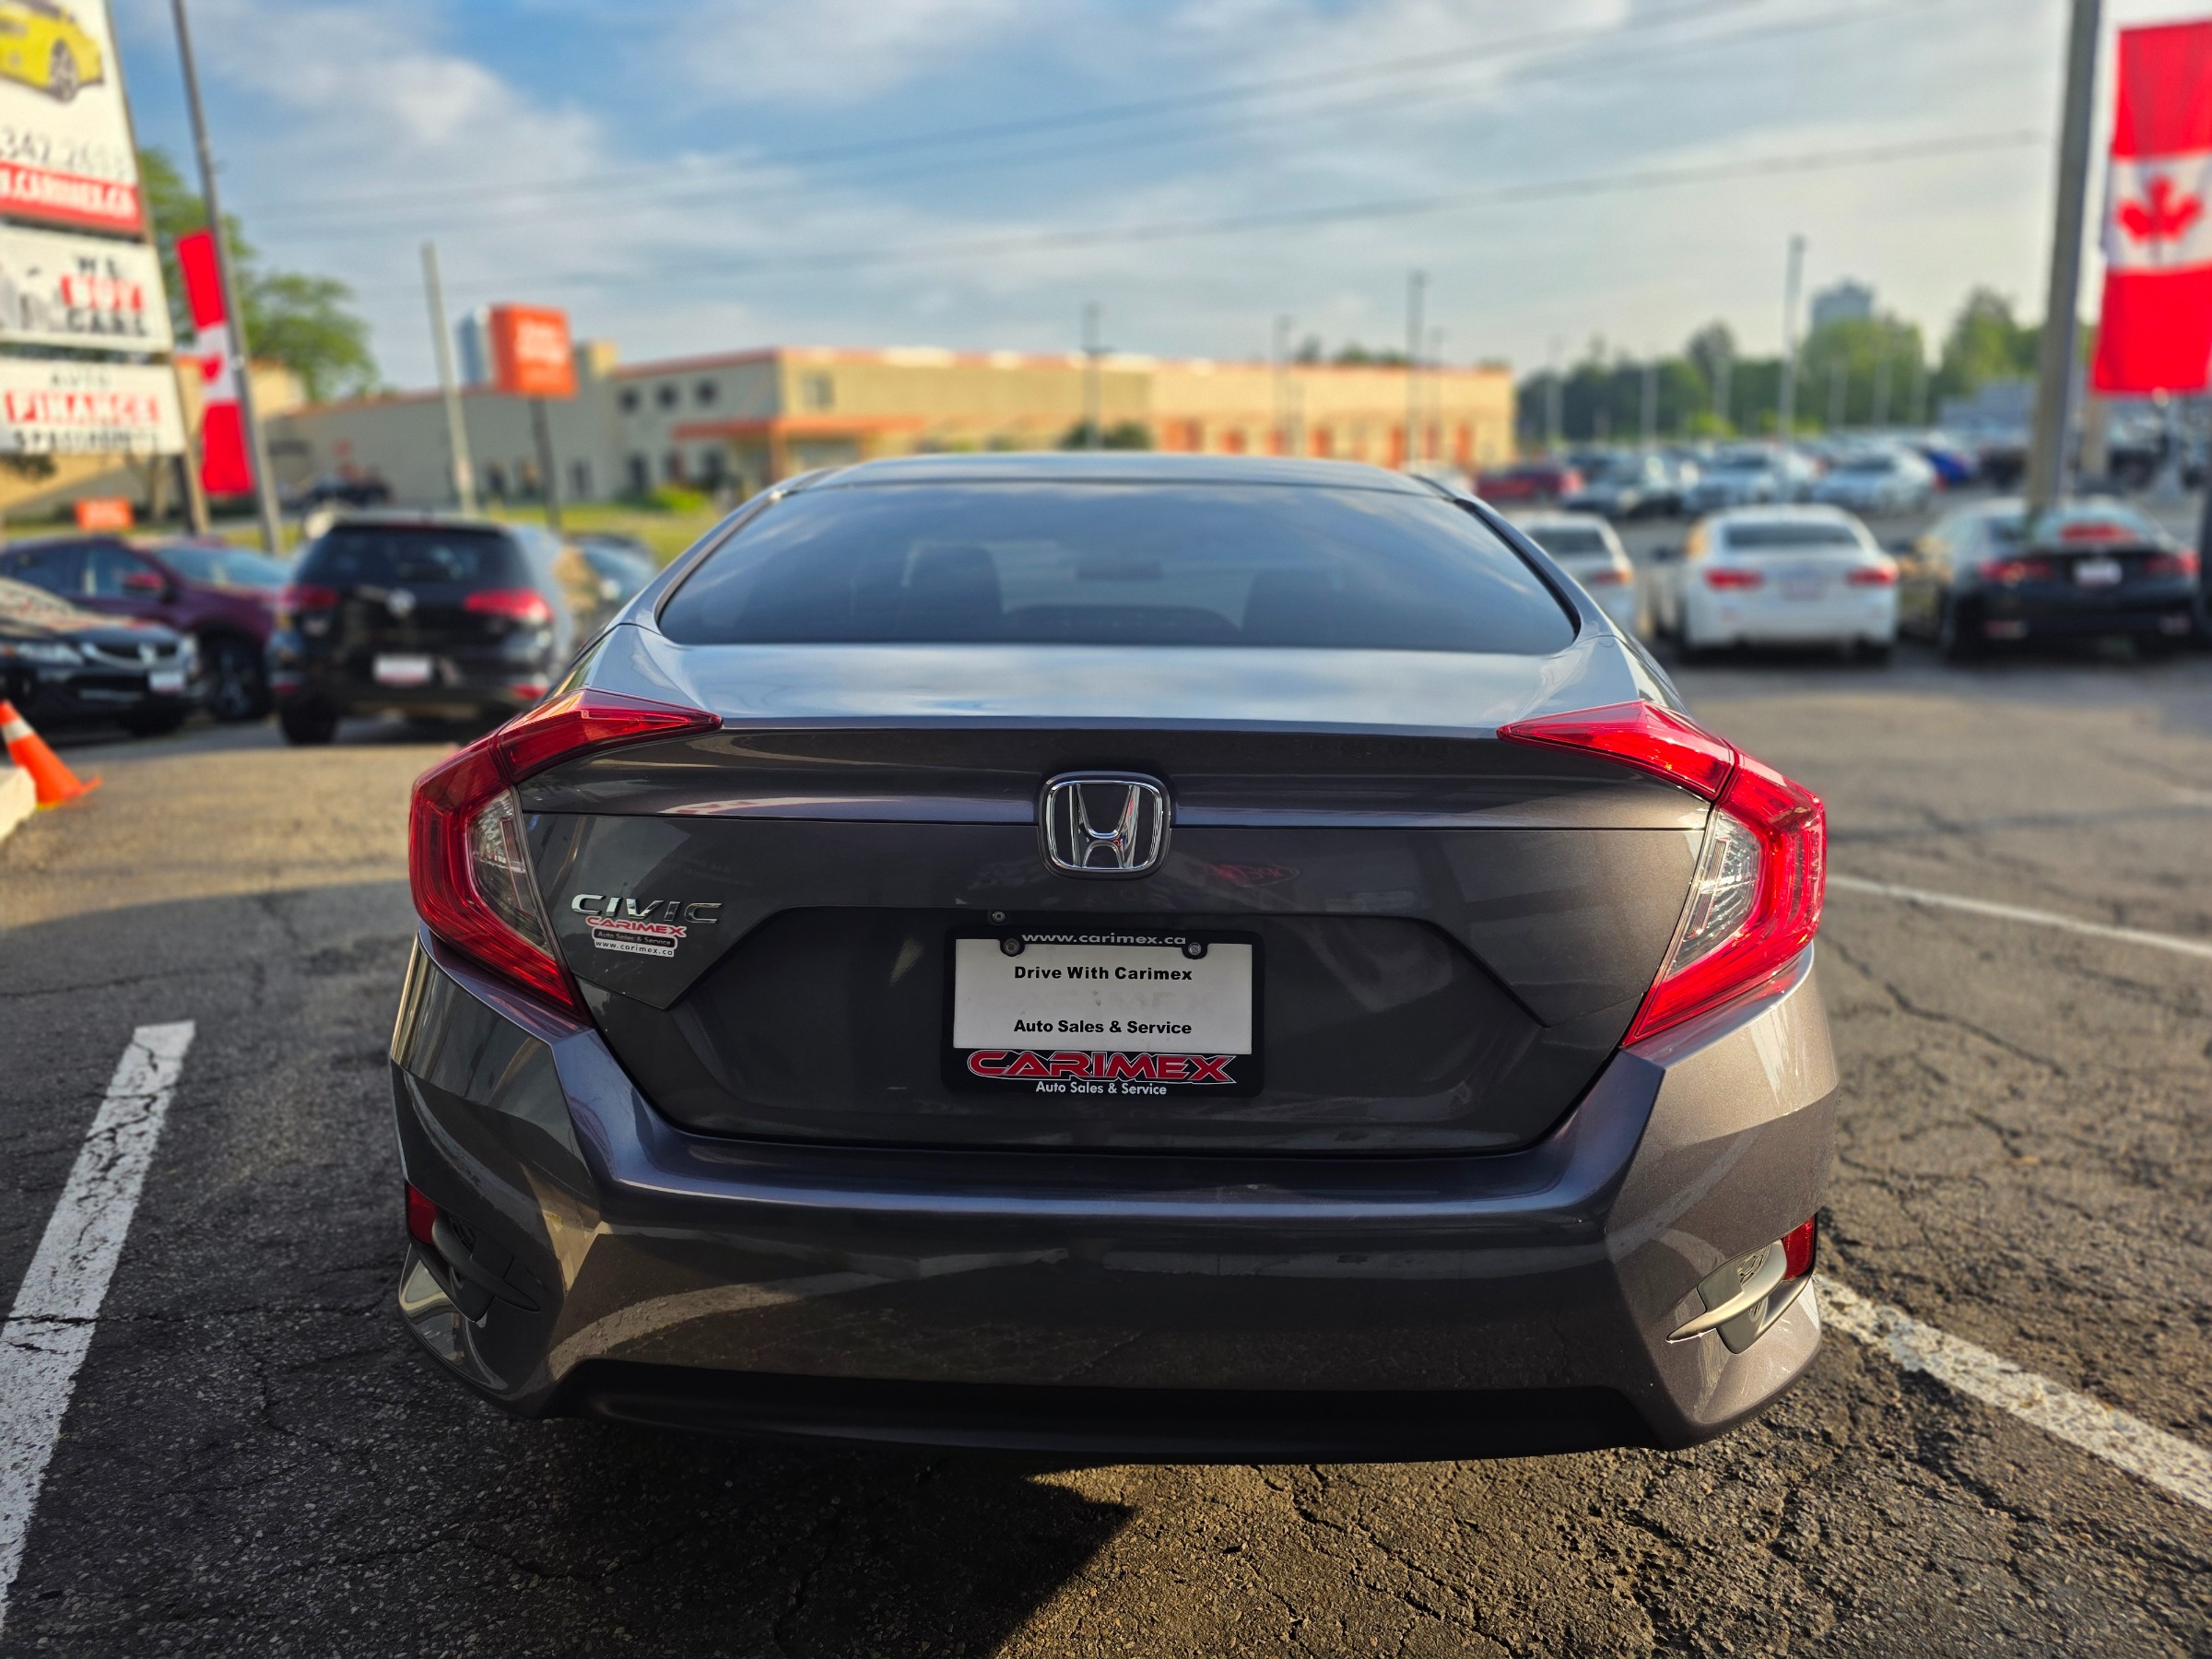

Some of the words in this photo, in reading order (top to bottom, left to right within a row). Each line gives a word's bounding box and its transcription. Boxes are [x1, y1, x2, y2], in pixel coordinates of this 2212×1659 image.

[571, 893, 723, 924] CIVIC
[586, 916, 686, 936] CARIMEX
[644, 936, 672, 946] Service
[1021, 932, 1186, 945] www.carimex.ca
[595, 941, 673, 956] www.carimex.ca
[1014, 966, 1062, 980] Drive
[1067, 966, 1110, 980] With
[1114, 967, 1194, 981] Carimex
[1014, 1019, 1053, 1032] Auto
[1057, 1019, 1104, 1033] Sales
[1109, 1020, 1122, 1033] &
[1127, 1020, 1192, 1034] Service
[968, 1049, 1236, 1084] CARIMEX
[1036, 1080, 1066, 1093] Auto
[1070, 1081, 1104, 1094] Sales
[1108, 1083, 1117, 1094] &
[1122, 1082, 1167, 1095] Service
